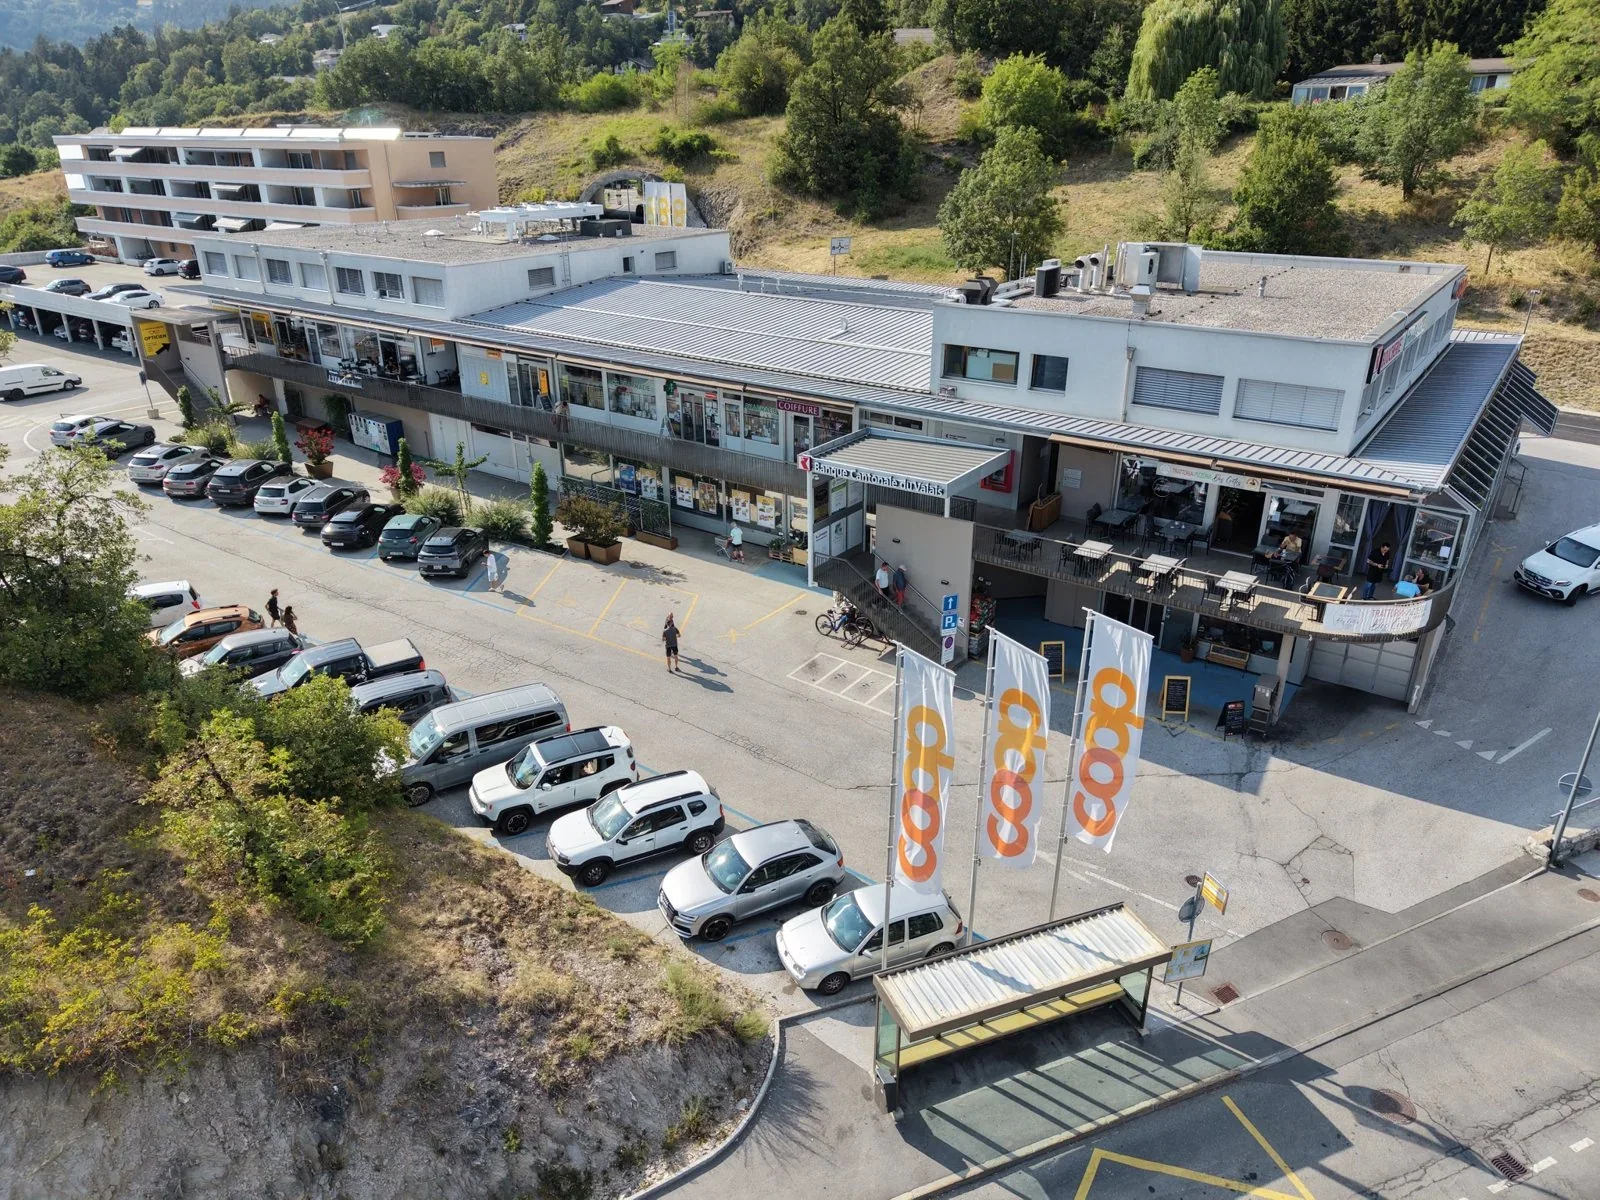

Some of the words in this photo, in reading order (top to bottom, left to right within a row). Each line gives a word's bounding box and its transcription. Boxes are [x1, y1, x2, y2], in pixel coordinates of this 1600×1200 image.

[778, 401, 818, 414] COIFFURE
[814, 462, 848, 478] Banque
[850, 469, 898, 487] Cantonale
[900, 478, 914, 490] du
[914, 481, 945, 496] Valais
[898, 705, 955, 883] coop
[987, 688, 1048, 857] coop
[1073, 667, 1144, 837] coop
